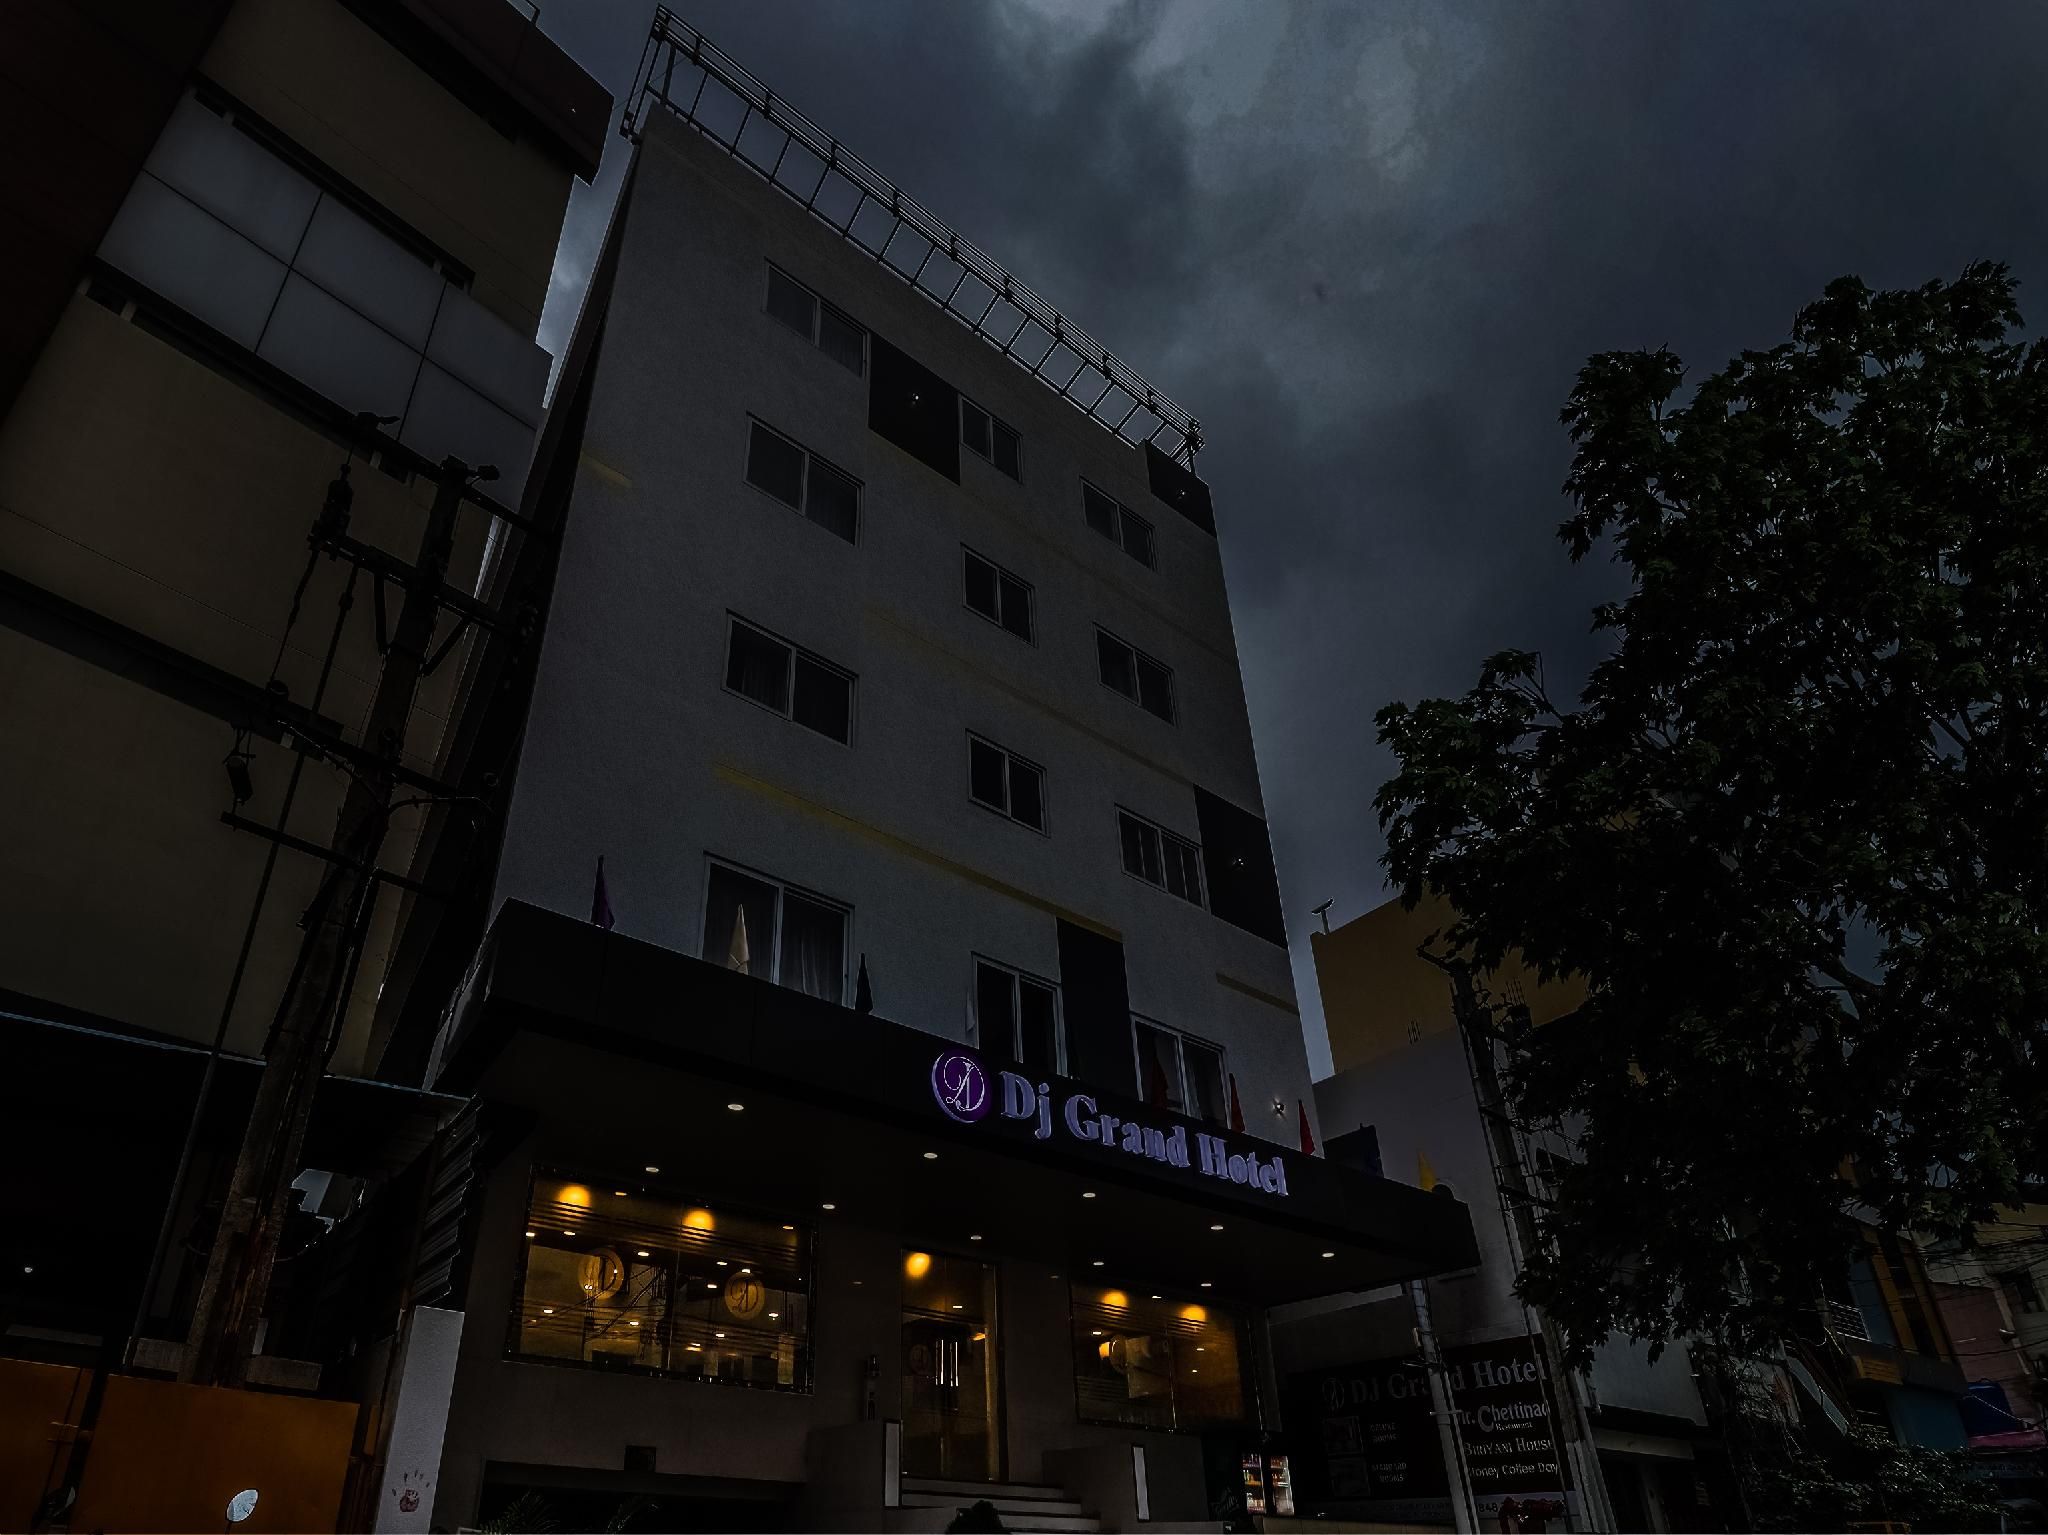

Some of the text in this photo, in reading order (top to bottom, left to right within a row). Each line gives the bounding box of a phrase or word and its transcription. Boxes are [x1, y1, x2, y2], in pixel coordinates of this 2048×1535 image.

[998, 1070, 1289, 1197] Dj Grand Hotel
